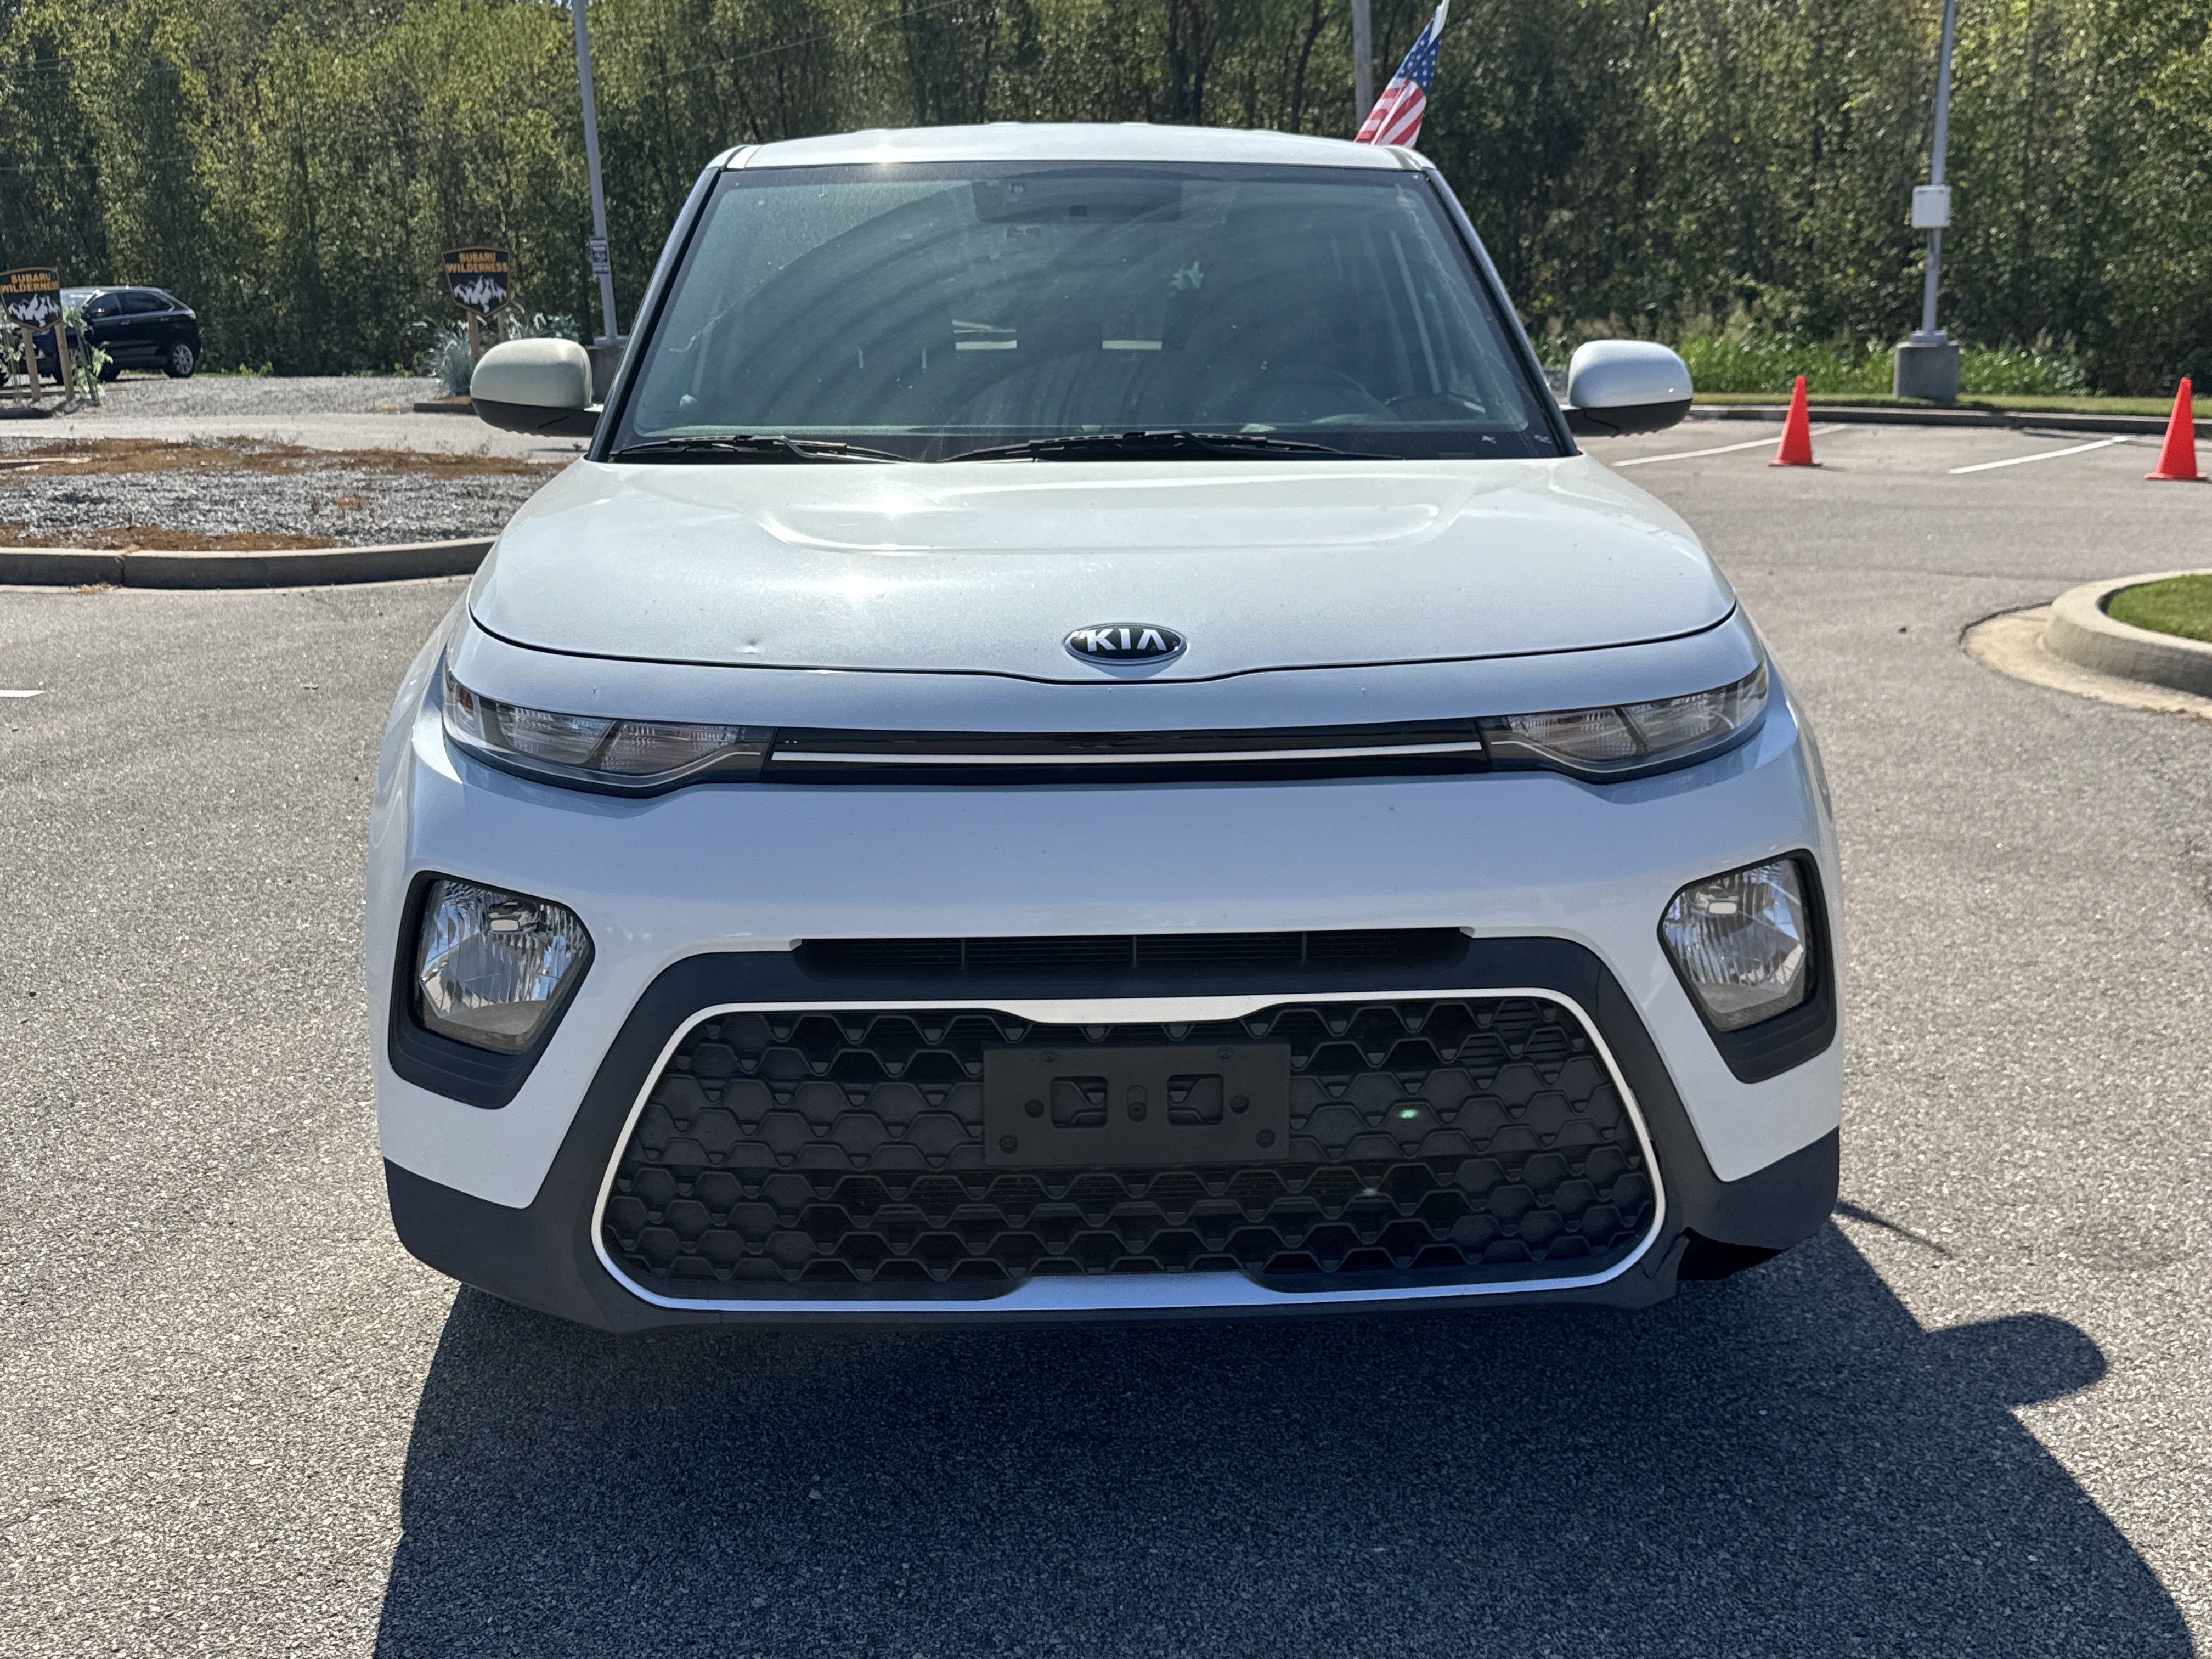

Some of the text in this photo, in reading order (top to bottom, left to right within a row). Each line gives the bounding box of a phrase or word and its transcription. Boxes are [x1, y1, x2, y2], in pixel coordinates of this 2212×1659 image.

[459, 252, 496, 262] SUBARU
[446, 262, 508, 273] WILDERNESS
[11, 272, 50, 284] SUBARU
[1085, 628, 1167, 652] KIA
